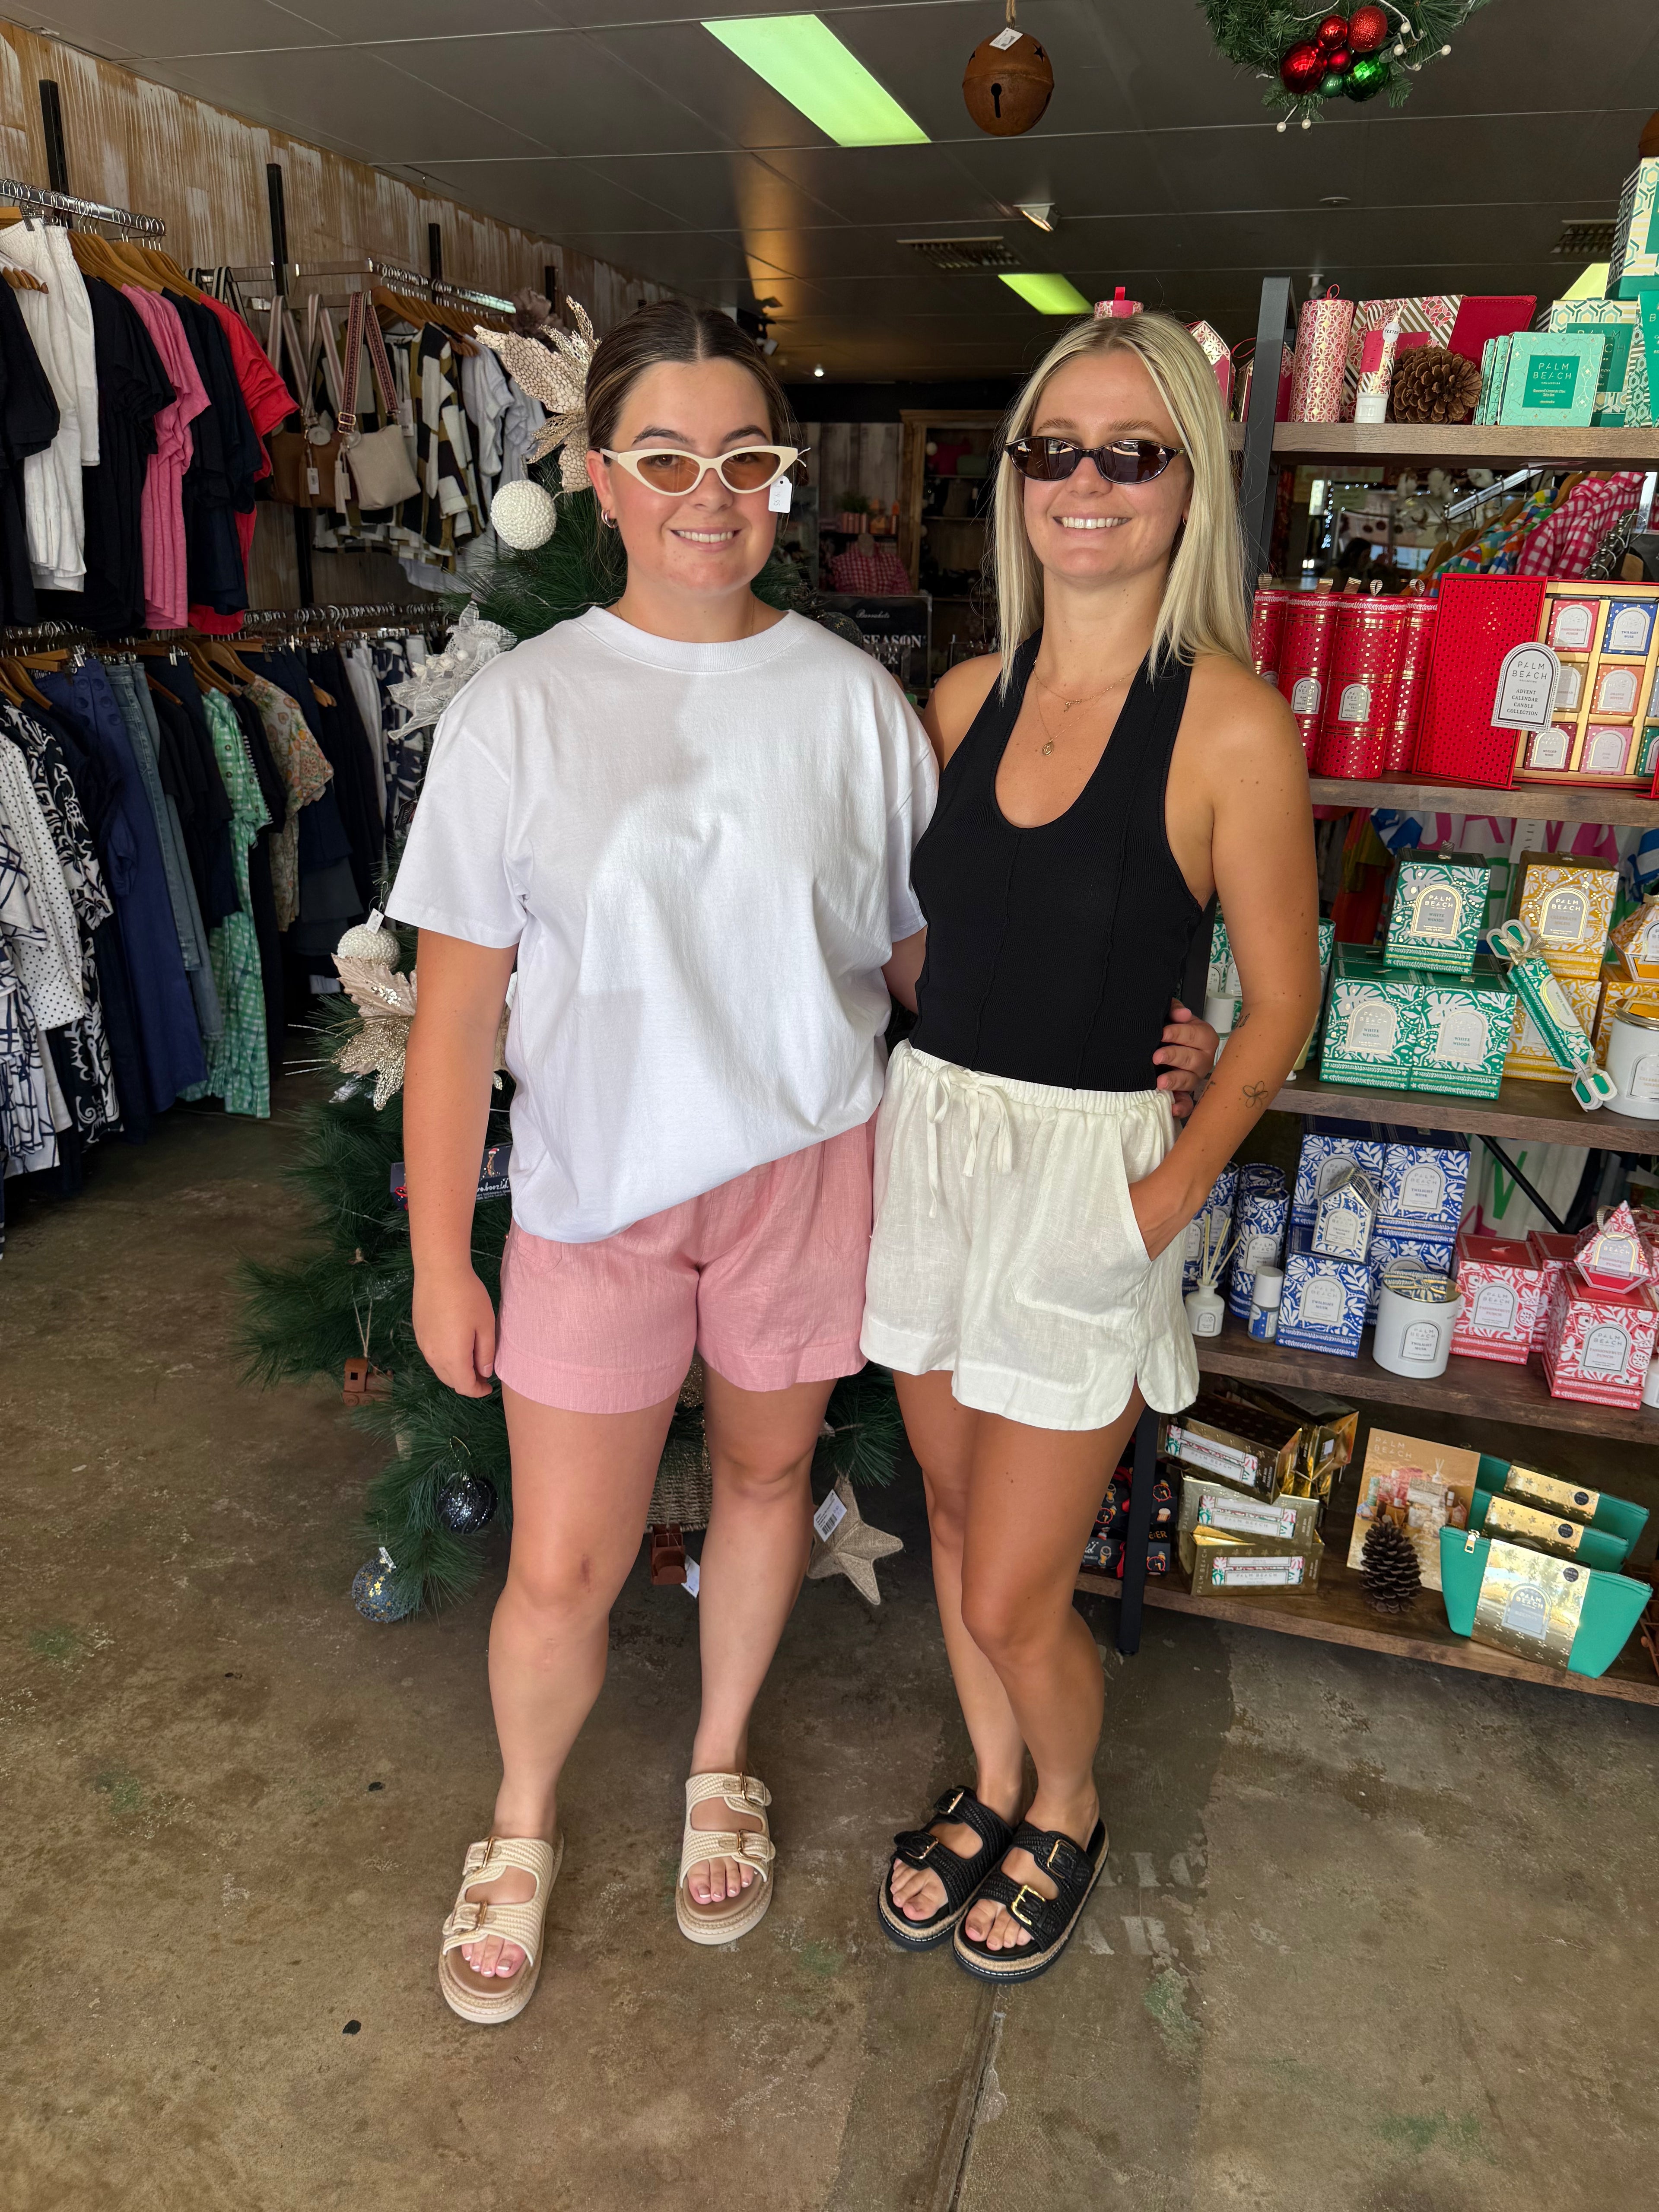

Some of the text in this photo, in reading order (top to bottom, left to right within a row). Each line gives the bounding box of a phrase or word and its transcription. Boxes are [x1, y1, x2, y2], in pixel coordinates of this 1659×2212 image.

[1518, 661, 1545, 670] PALM
[1512, 670, 1547, 680] BEACH
[1603, 1246, 1630, 1255] BEACH
[1594, 1338, 1622, 1346] BEACH
[1375, 1437, 1405, 1449] PALM
[1374, 1444, 1412, 1459] BEACH
[1520, 1592, 1541, 1603] PALM
